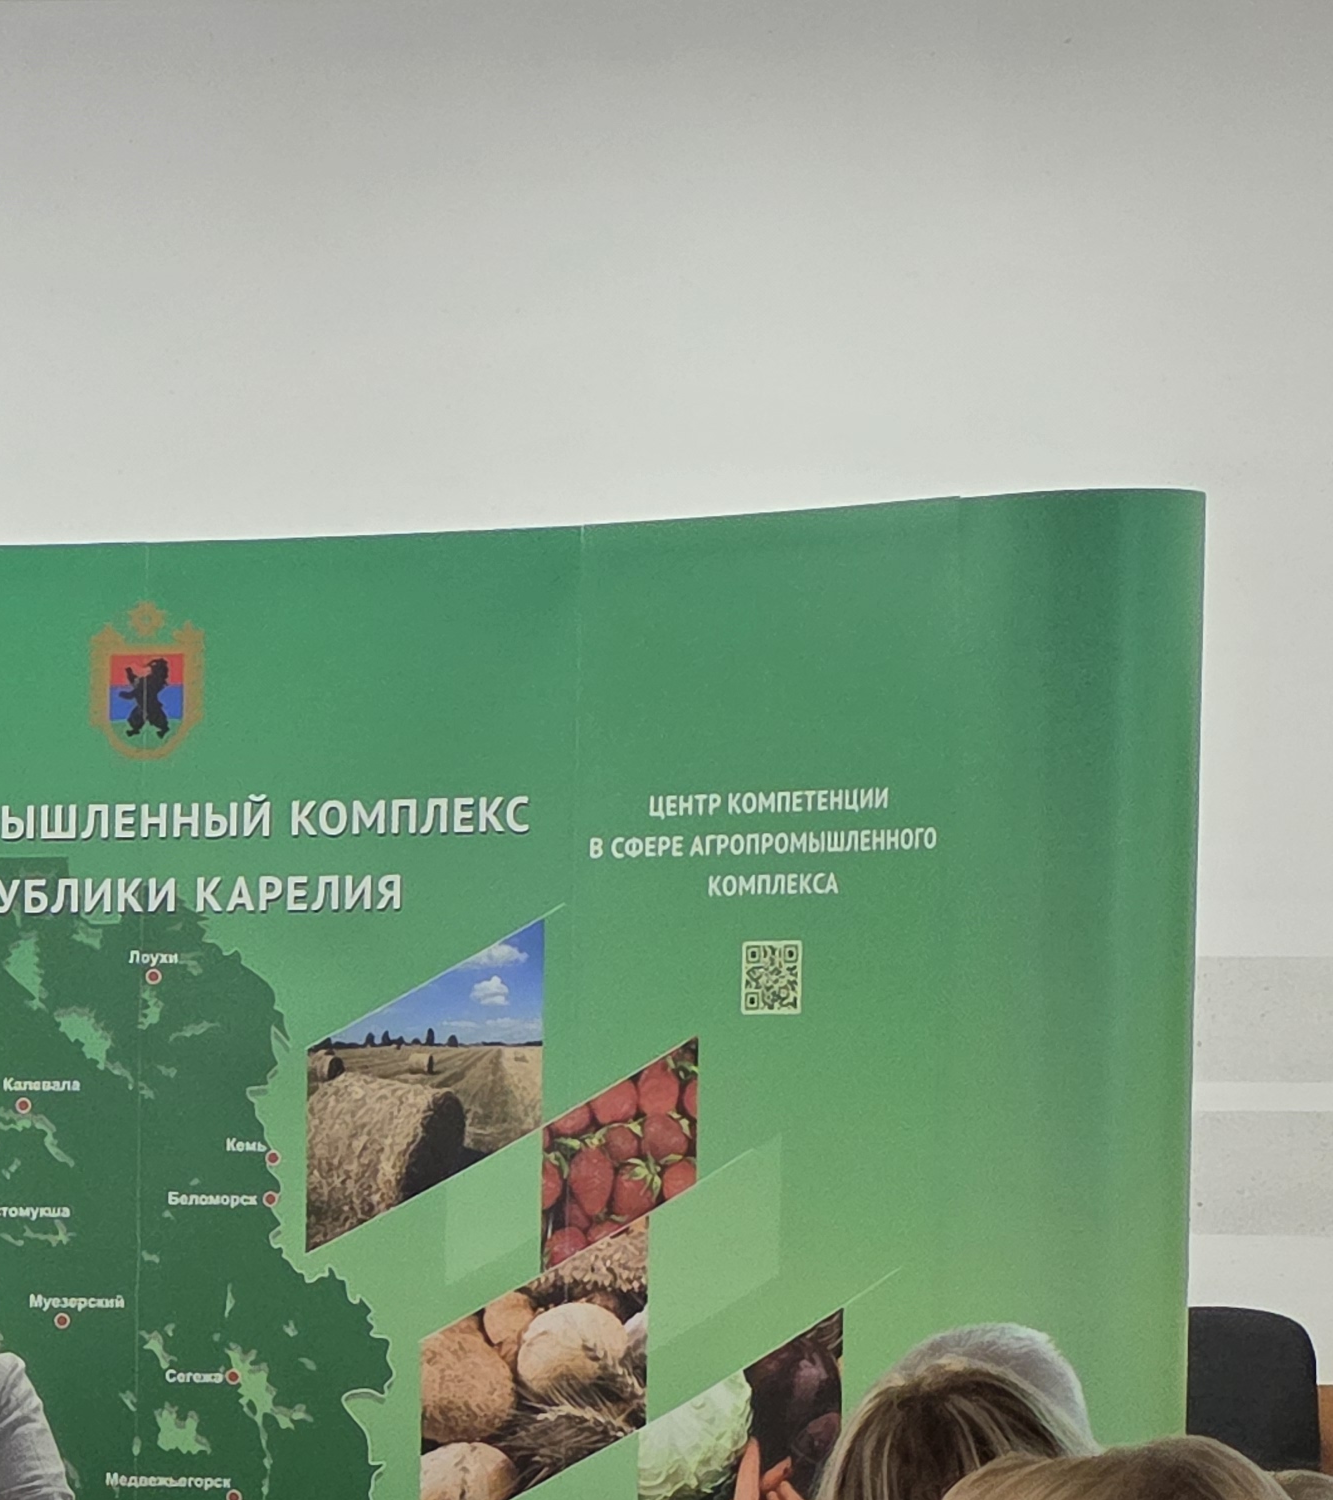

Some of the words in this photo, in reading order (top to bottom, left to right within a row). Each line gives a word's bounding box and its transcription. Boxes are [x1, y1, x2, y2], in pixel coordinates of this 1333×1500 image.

[290, 795, 531, 836] КОМПЛЕКС
[649, 794, 722, 820] ЦЕНТР
[728, 787, 890, 815] КОМПЕТЕНЦИИ
[589, 837, 603, 859] В
[611, 835, 684, 859] СФЕРЕ
[689, 826, 938, 857] АГРОПРОМЫШЛЕННОГО
[194, 874, 402, 913] КАРЕЛИЯ
[707, 872, 839, 898] КОМПЛЕКСА
[128, 950, 179, 968] Лоухи
[225, 1137, 267, 1152] Кемь
[167, 1190, 258, 1208] Беломорск
